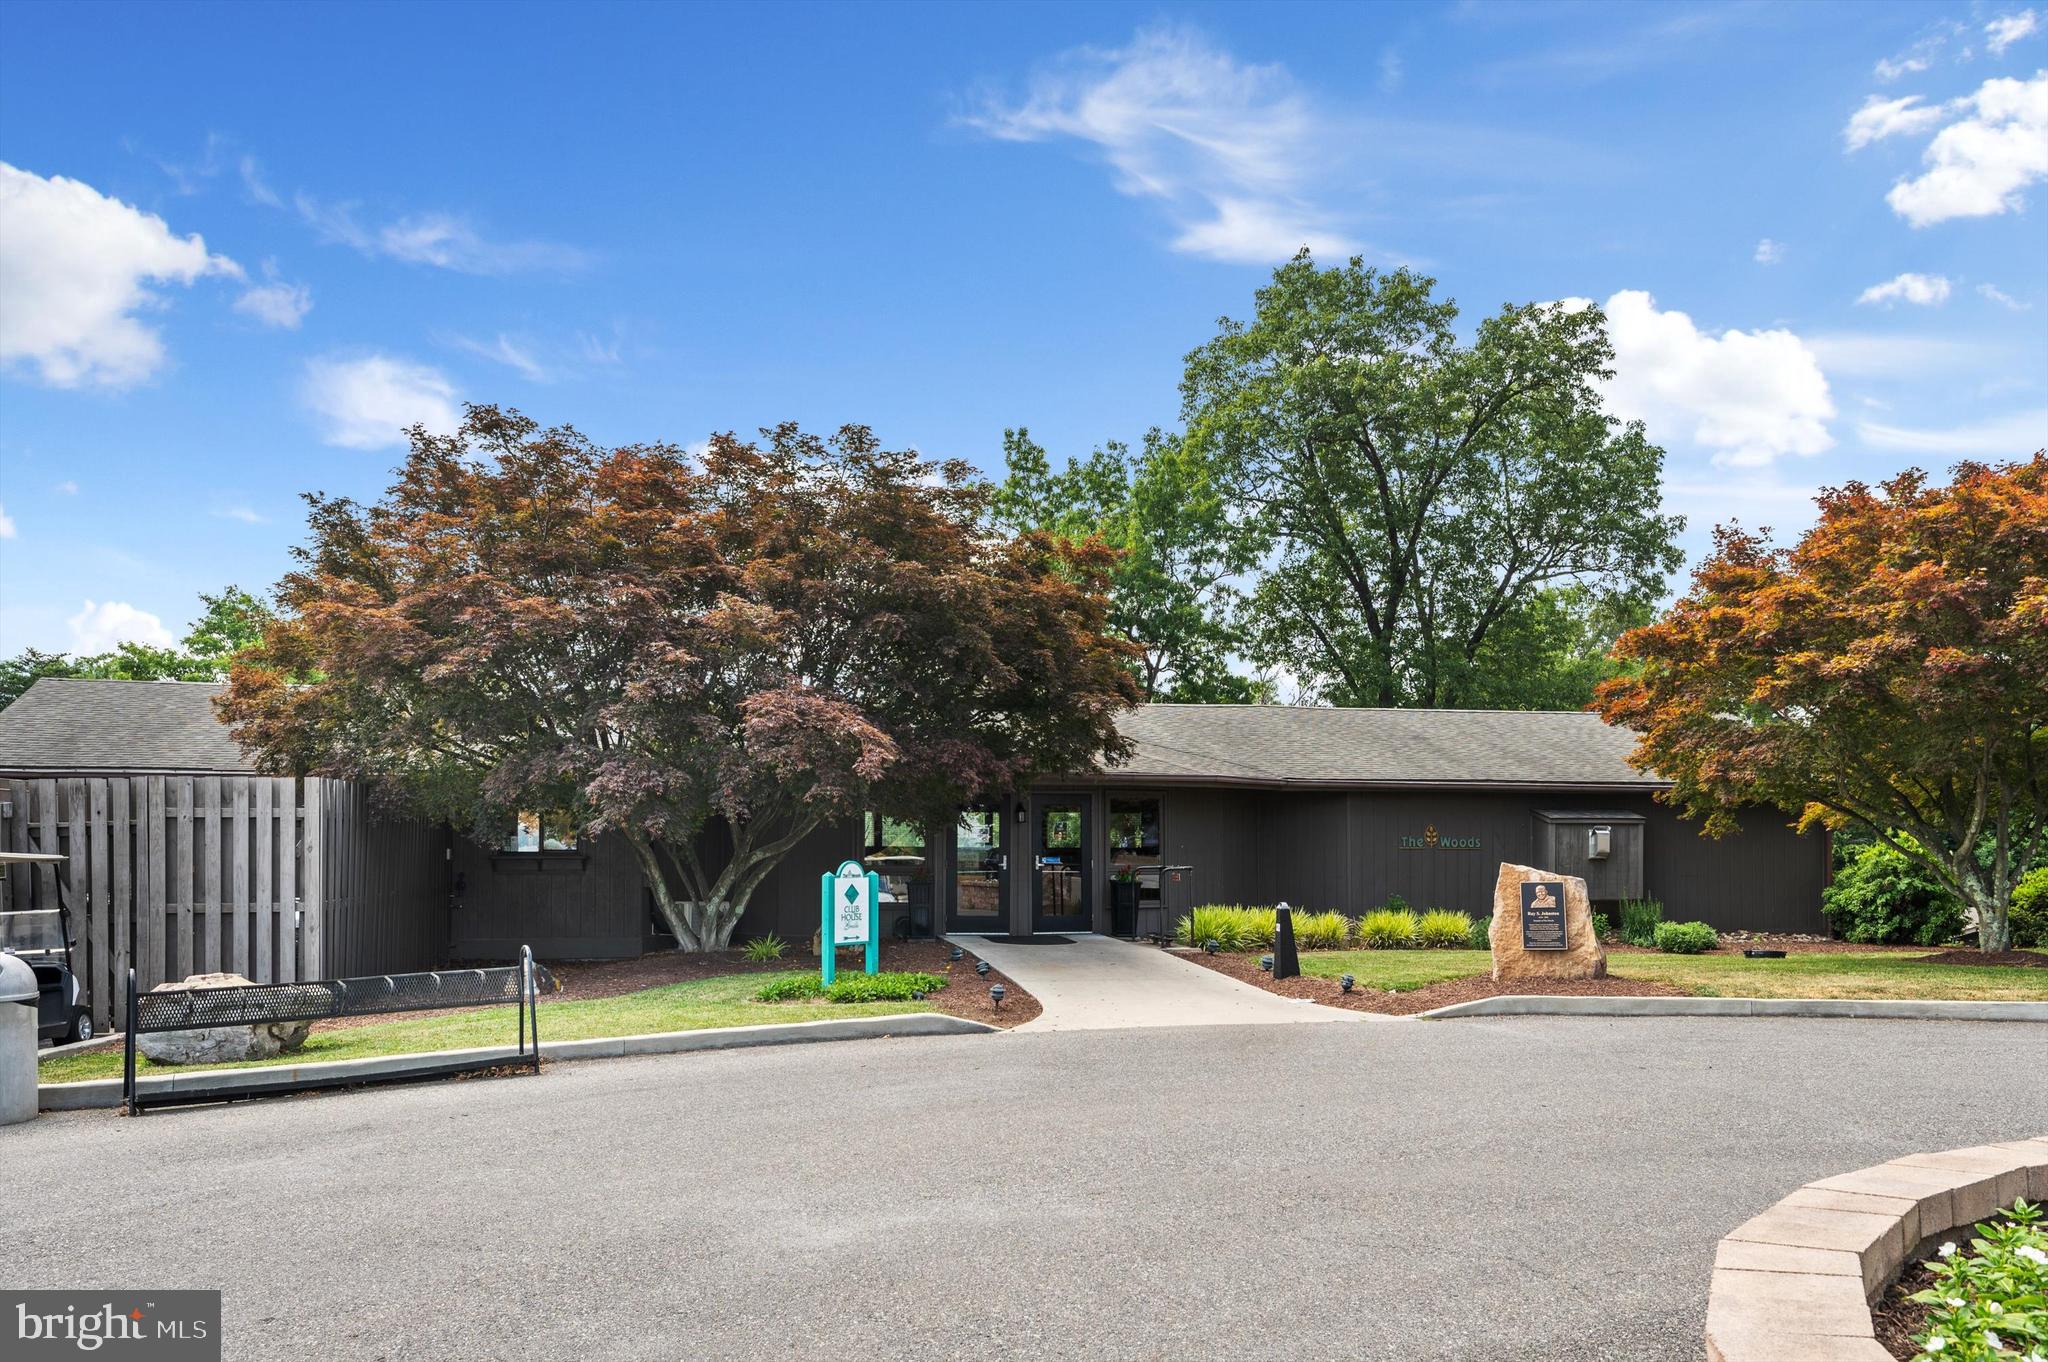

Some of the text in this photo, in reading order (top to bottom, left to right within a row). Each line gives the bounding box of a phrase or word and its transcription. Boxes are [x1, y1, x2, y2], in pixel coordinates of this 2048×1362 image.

[1400, 836, 1481, 847] The Woods
[843, 905, 860, 913] CLUB
[840, 913, 862, 921] HOUSE
